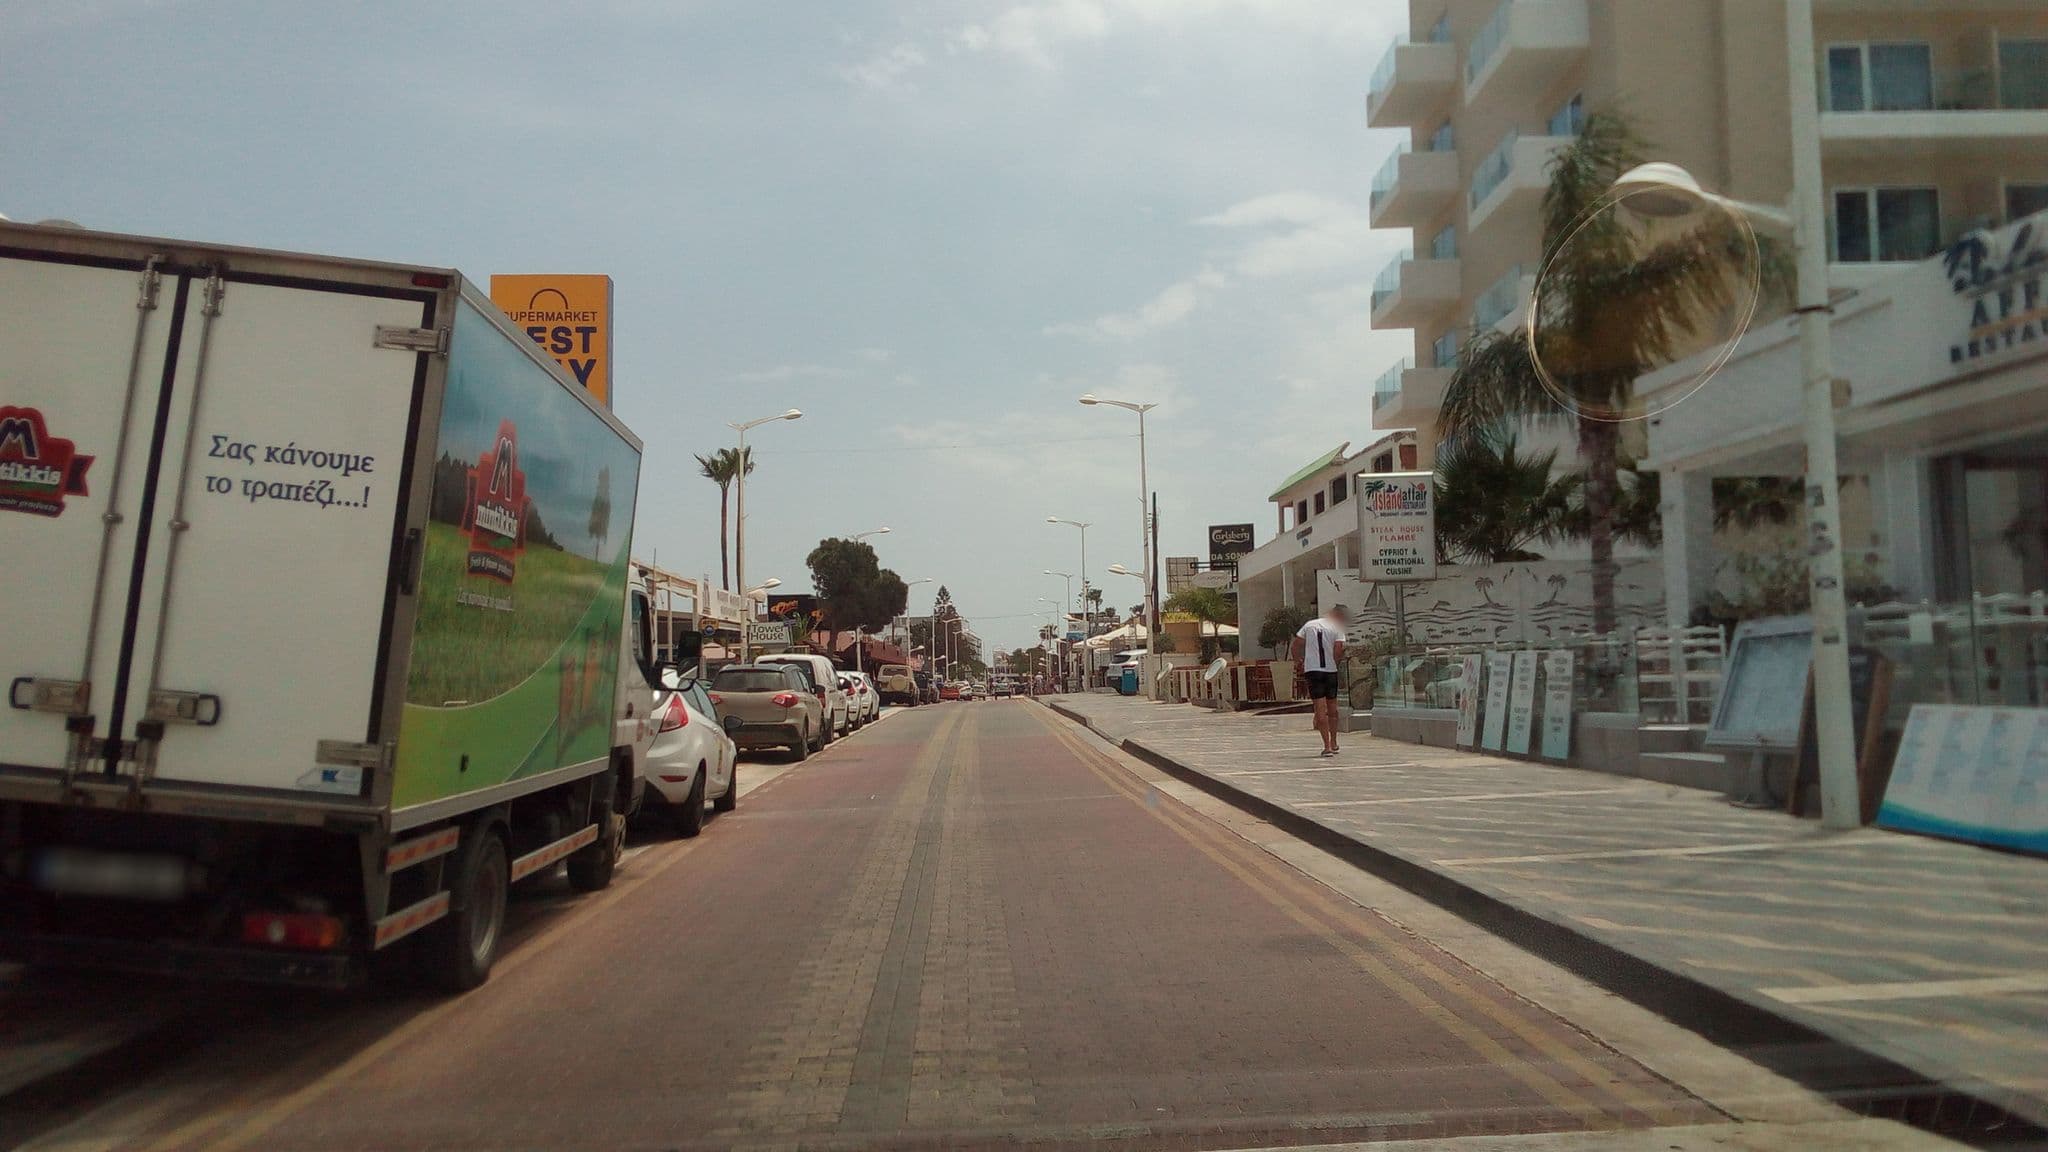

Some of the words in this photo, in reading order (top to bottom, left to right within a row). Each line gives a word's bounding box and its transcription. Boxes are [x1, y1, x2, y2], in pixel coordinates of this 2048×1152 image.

[1971, 278, 2048, 328] AFF
[526, 326, 598, 354] EST
[208, 434, 257, 465] Σας
[264, 442, 375, 477] κάνουμε
[0, 461, 61, 486] tikkis
[205, 475, 232, 494] το
[1400, 525, 1425, 533] HOUSE
[1211, 529, 1250, 545] Carlsberg
[1379, 547, 1408, 556] CYPRIOT
[1372, 557, 1425, 566] INTERNATIONAL
[1386, 567, 1412, 576] CUISINE
[751, 624, 784, 634] Tower
[750, 632, 784, 641] House
